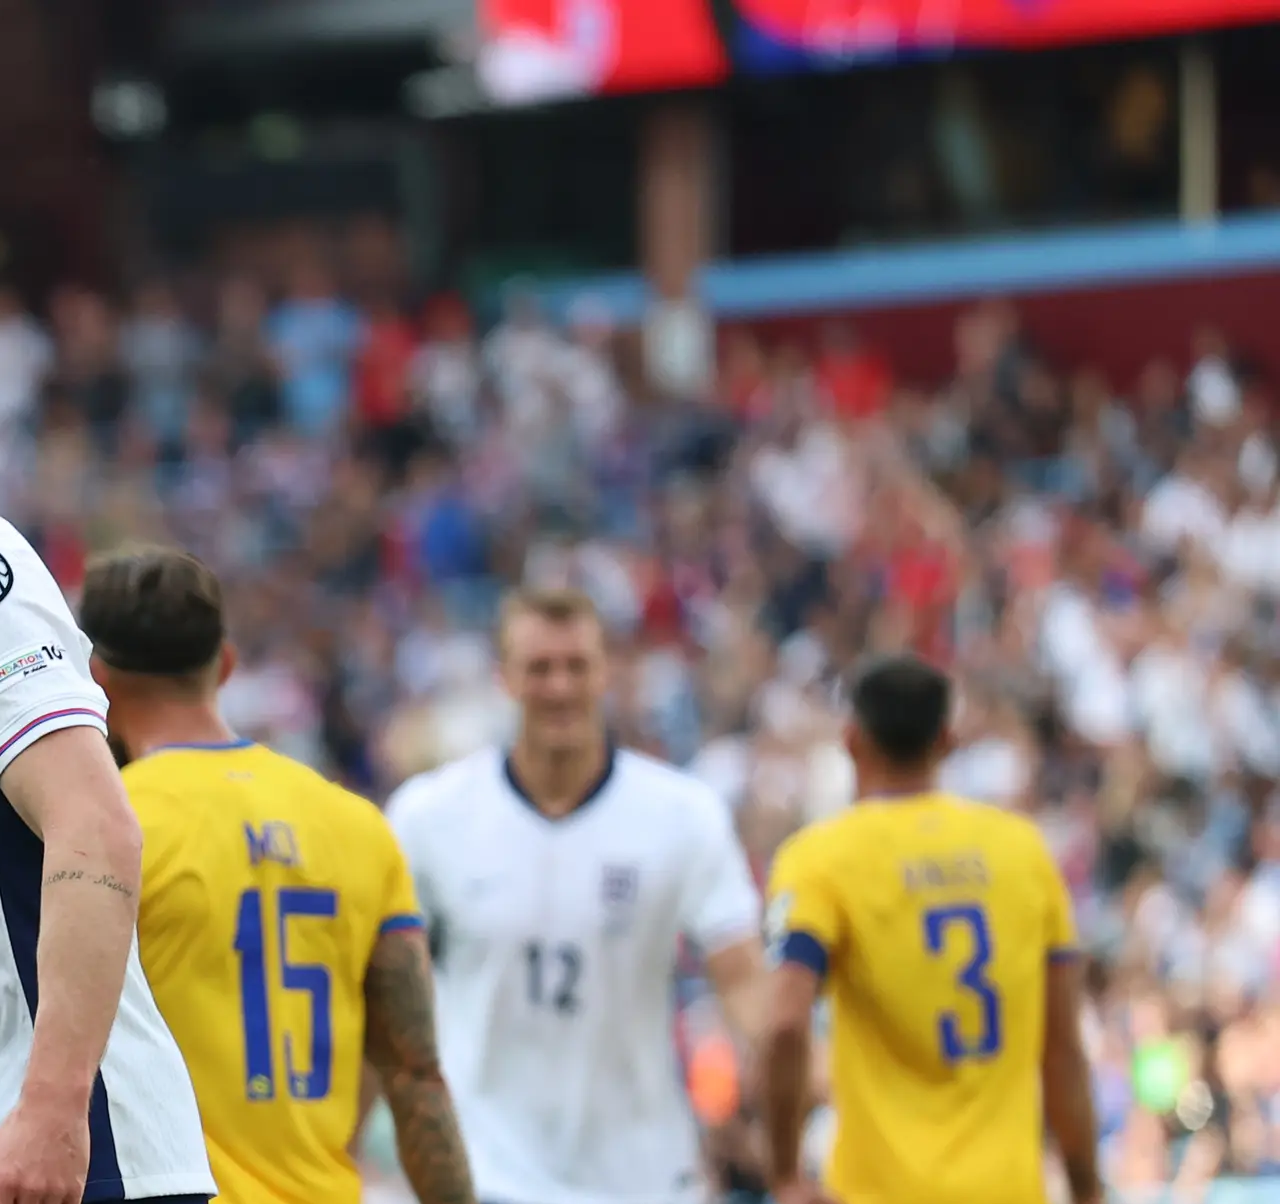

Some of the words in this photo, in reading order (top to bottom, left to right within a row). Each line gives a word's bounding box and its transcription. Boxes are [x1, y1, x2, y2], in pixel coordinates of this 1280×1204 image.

[233, 887, 337, 1101] 15
[524, 941, 583, 1011] 12
[923, 903, 1003, 1063] 3
